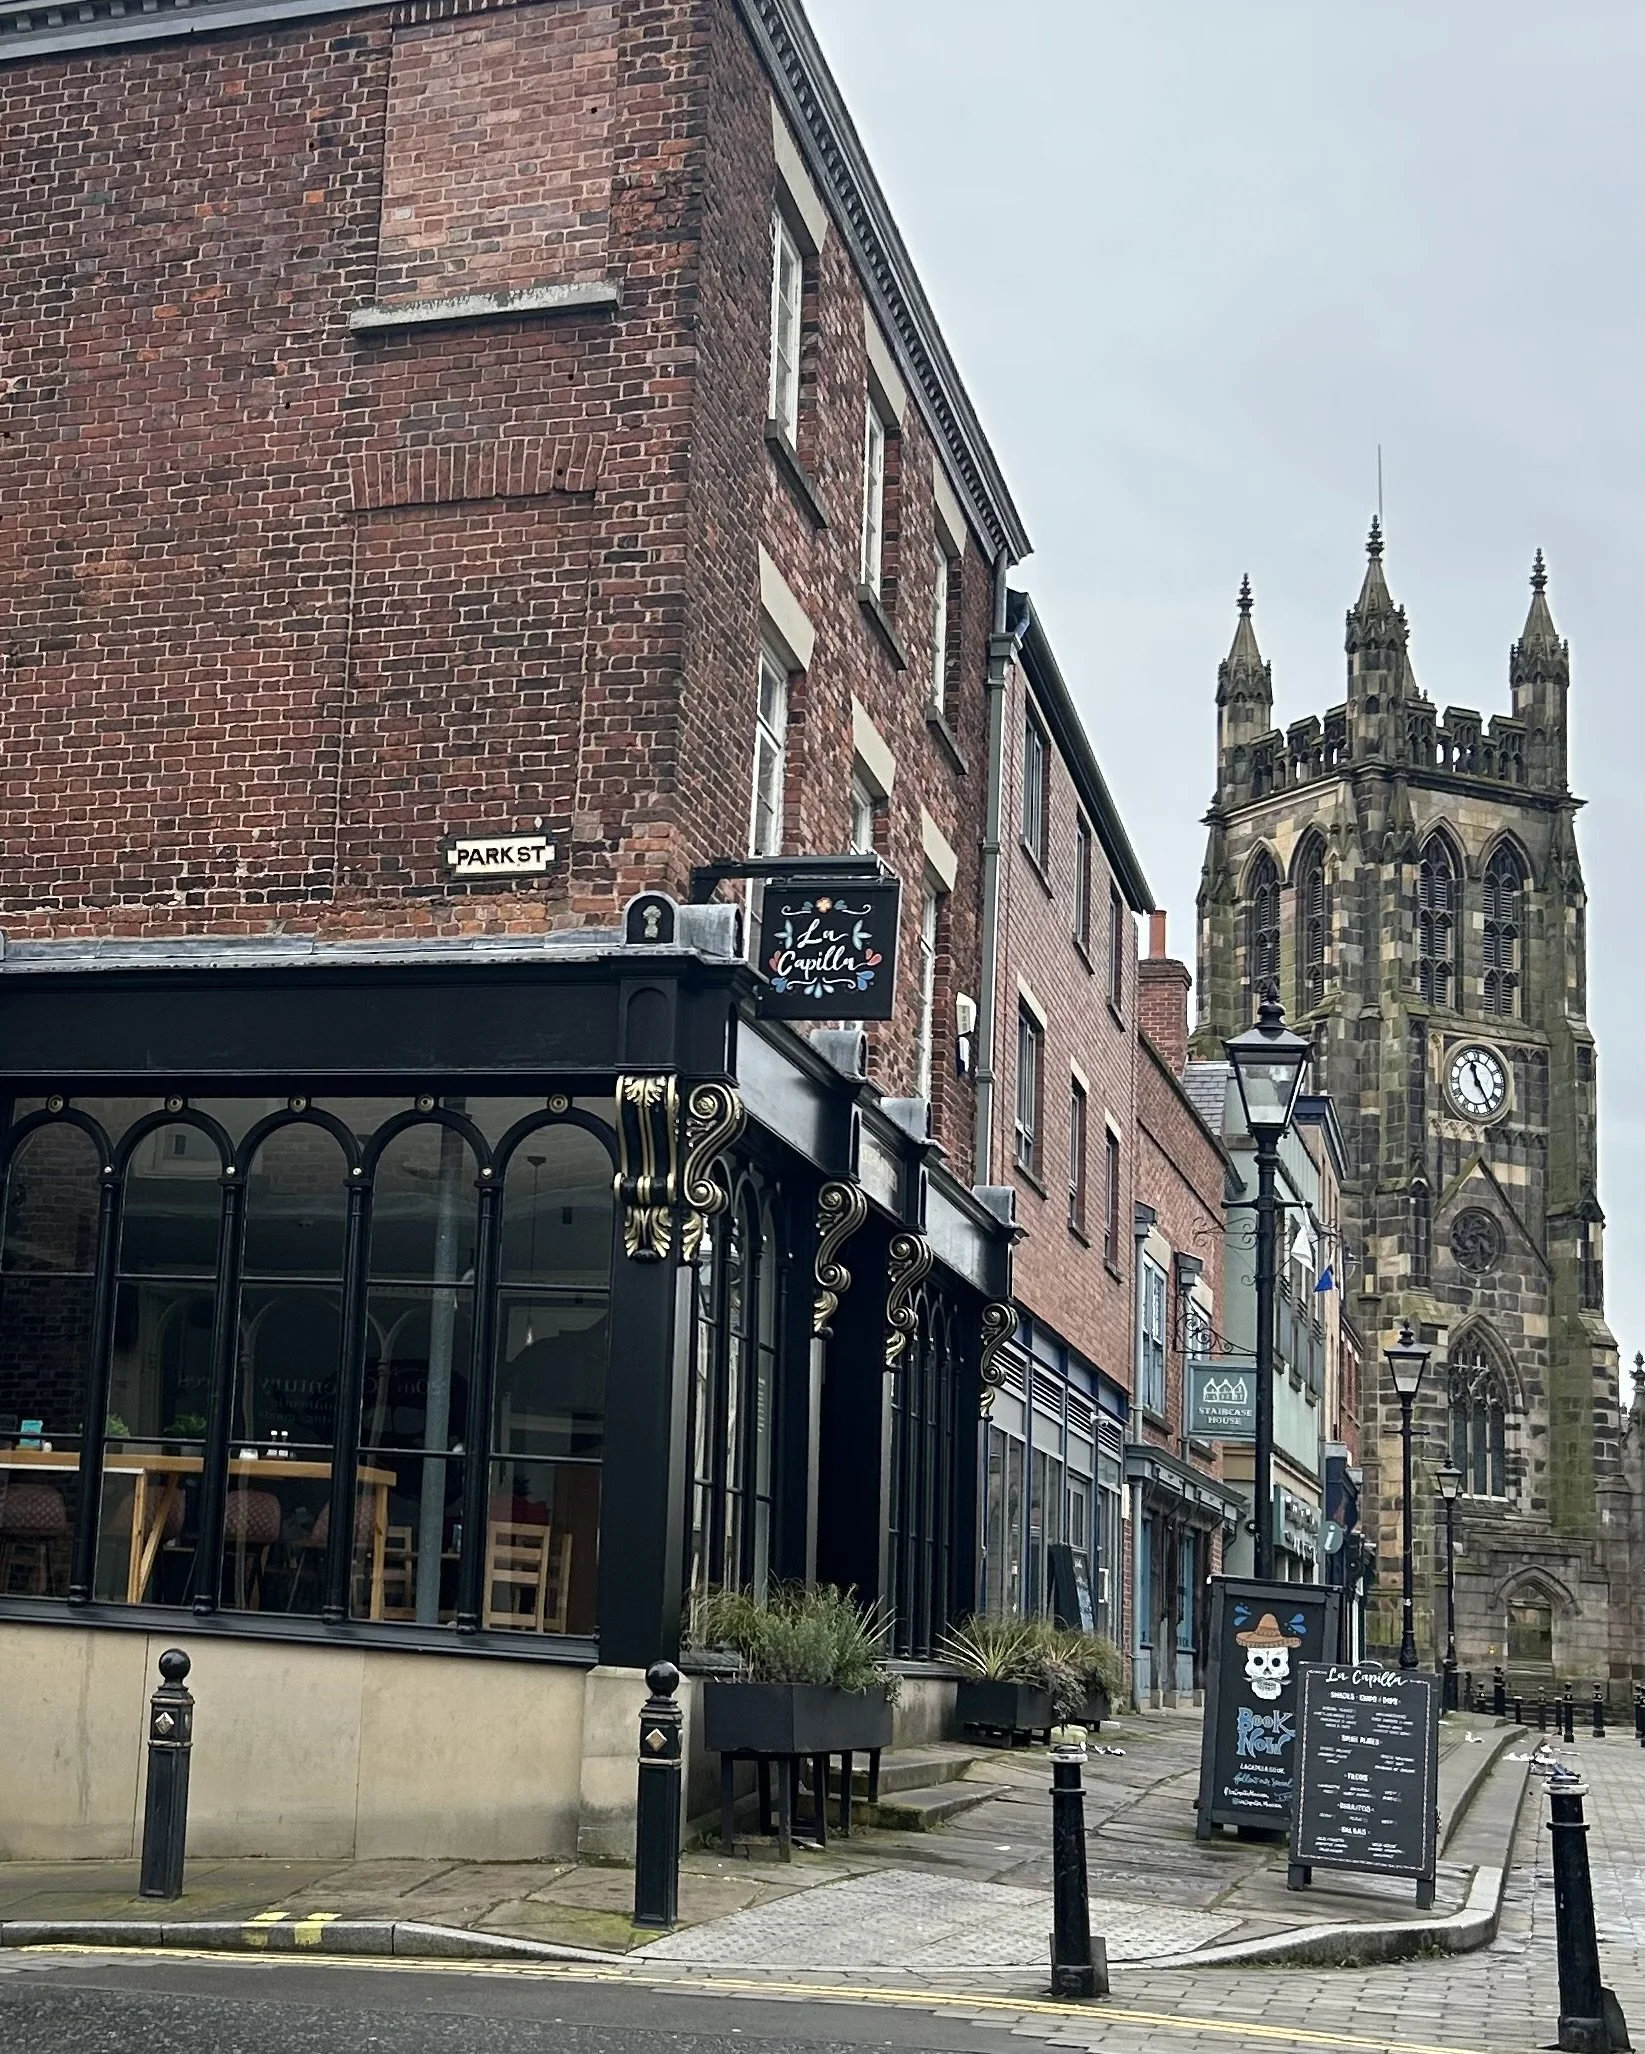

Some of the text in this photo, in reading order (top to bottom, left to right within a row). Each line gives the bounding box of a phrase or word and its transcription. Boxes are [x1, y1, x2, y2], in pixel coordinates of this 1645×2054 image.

[457, 845, 546, 866] PARK ST
[797, 918, 849, 949] La
[777, 945, 867, 980] Capilla
[1198, 1407, 1253, 1417] STAIRCASE
[1207, 1416, 1242, 1426] HOUSE
[1325, 1667, 1409, 1688] La Capilla
